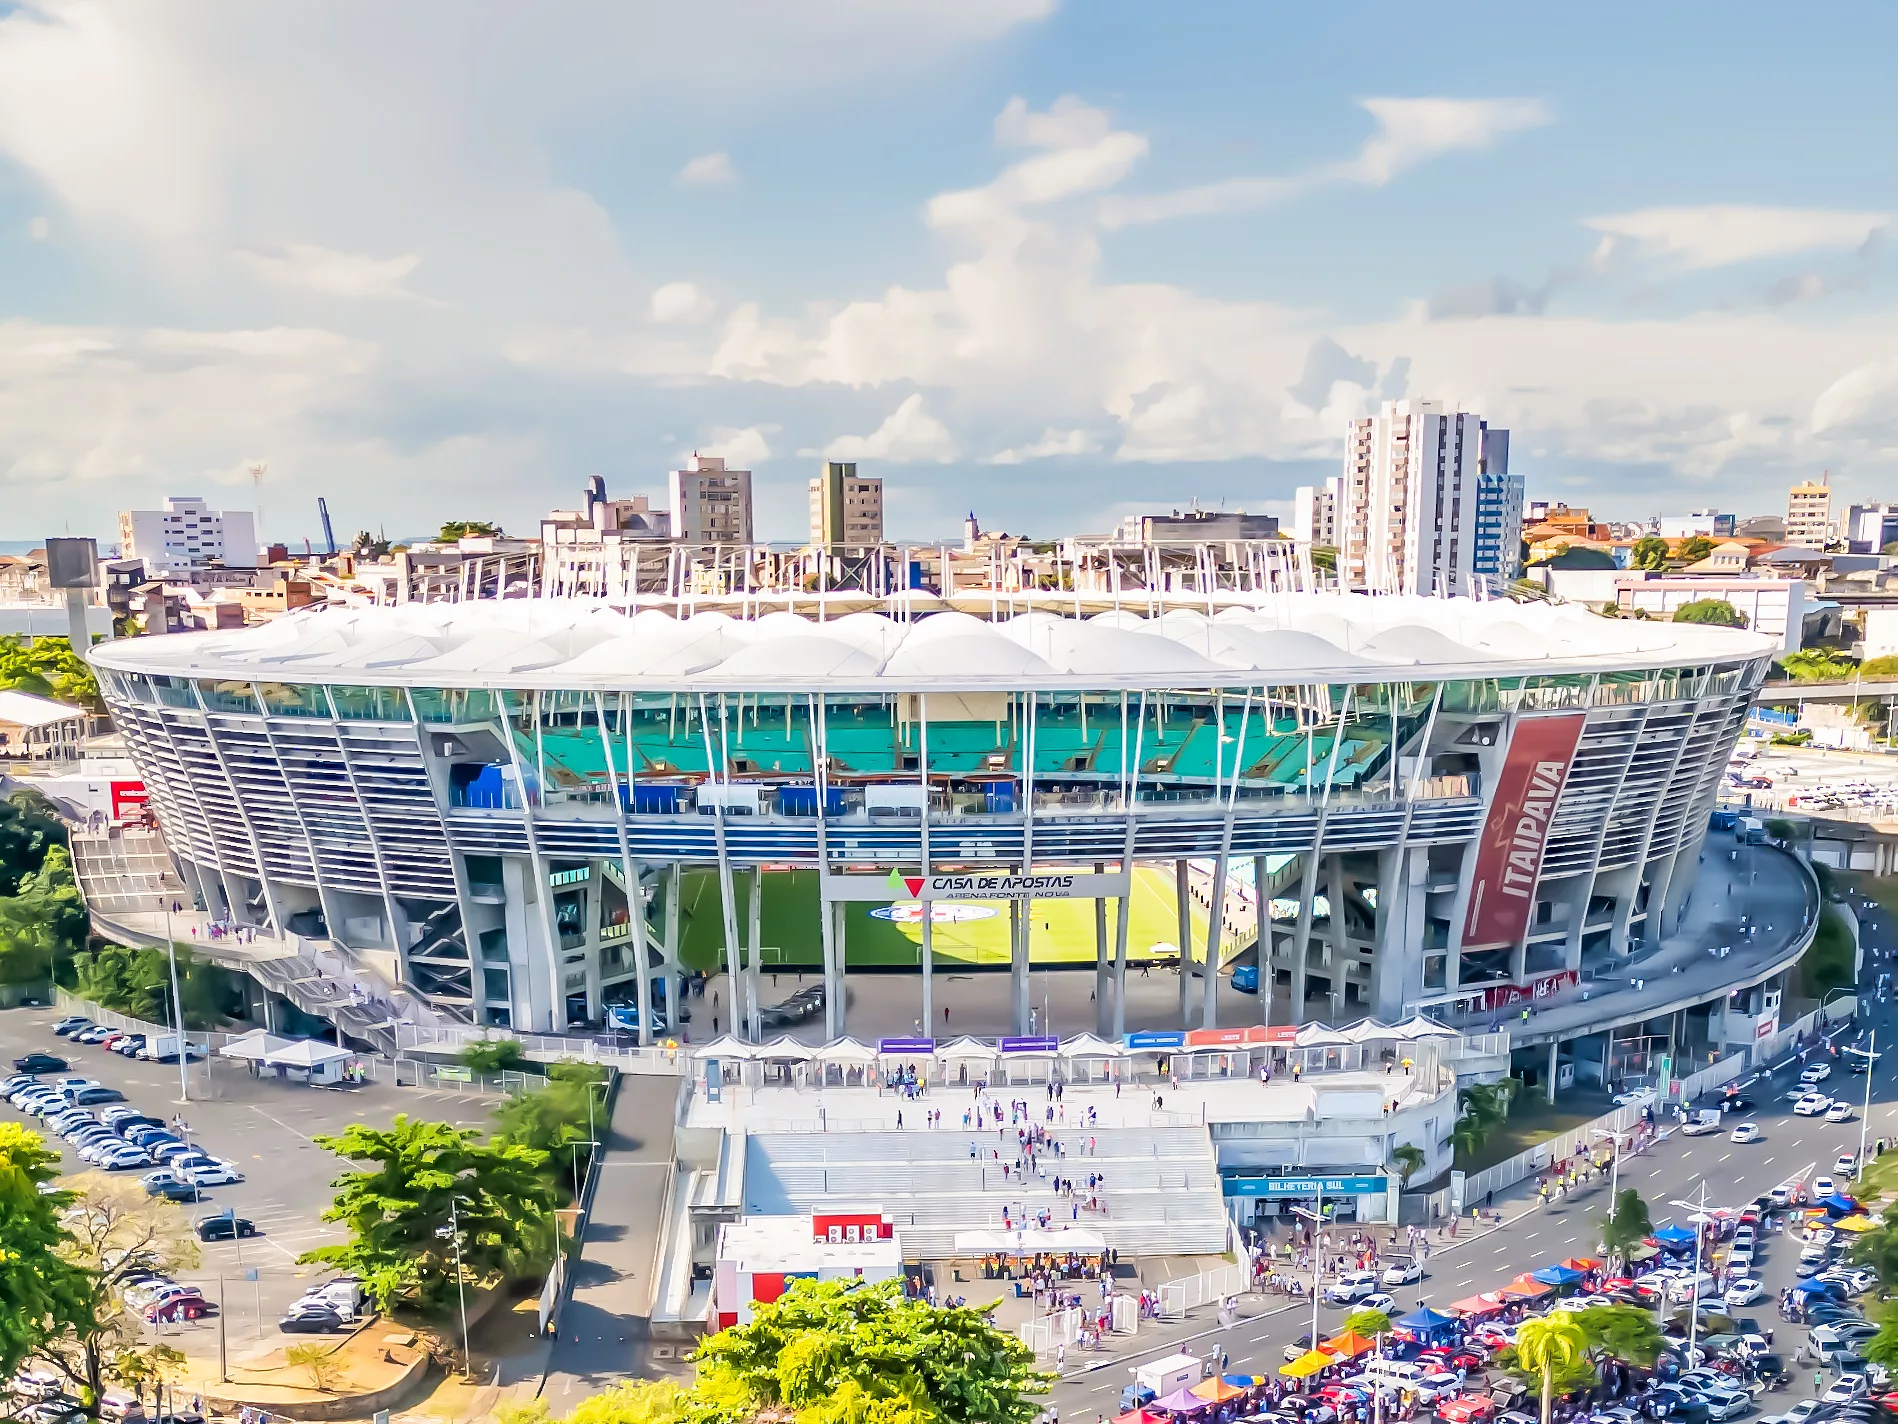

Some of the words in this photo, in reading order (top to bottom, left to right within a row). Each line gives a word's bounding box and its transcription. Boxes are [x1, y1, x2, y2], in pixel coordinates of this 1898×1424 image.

[1502, 761, 1565, 898] ITAIPAVA
[932, 877, 973, 890] CASA
[977, 877, 998, 890] DE
[1000, 876, 1074, 889] APOSTAS
[1326, 1180, 1344, 1190] SUL
